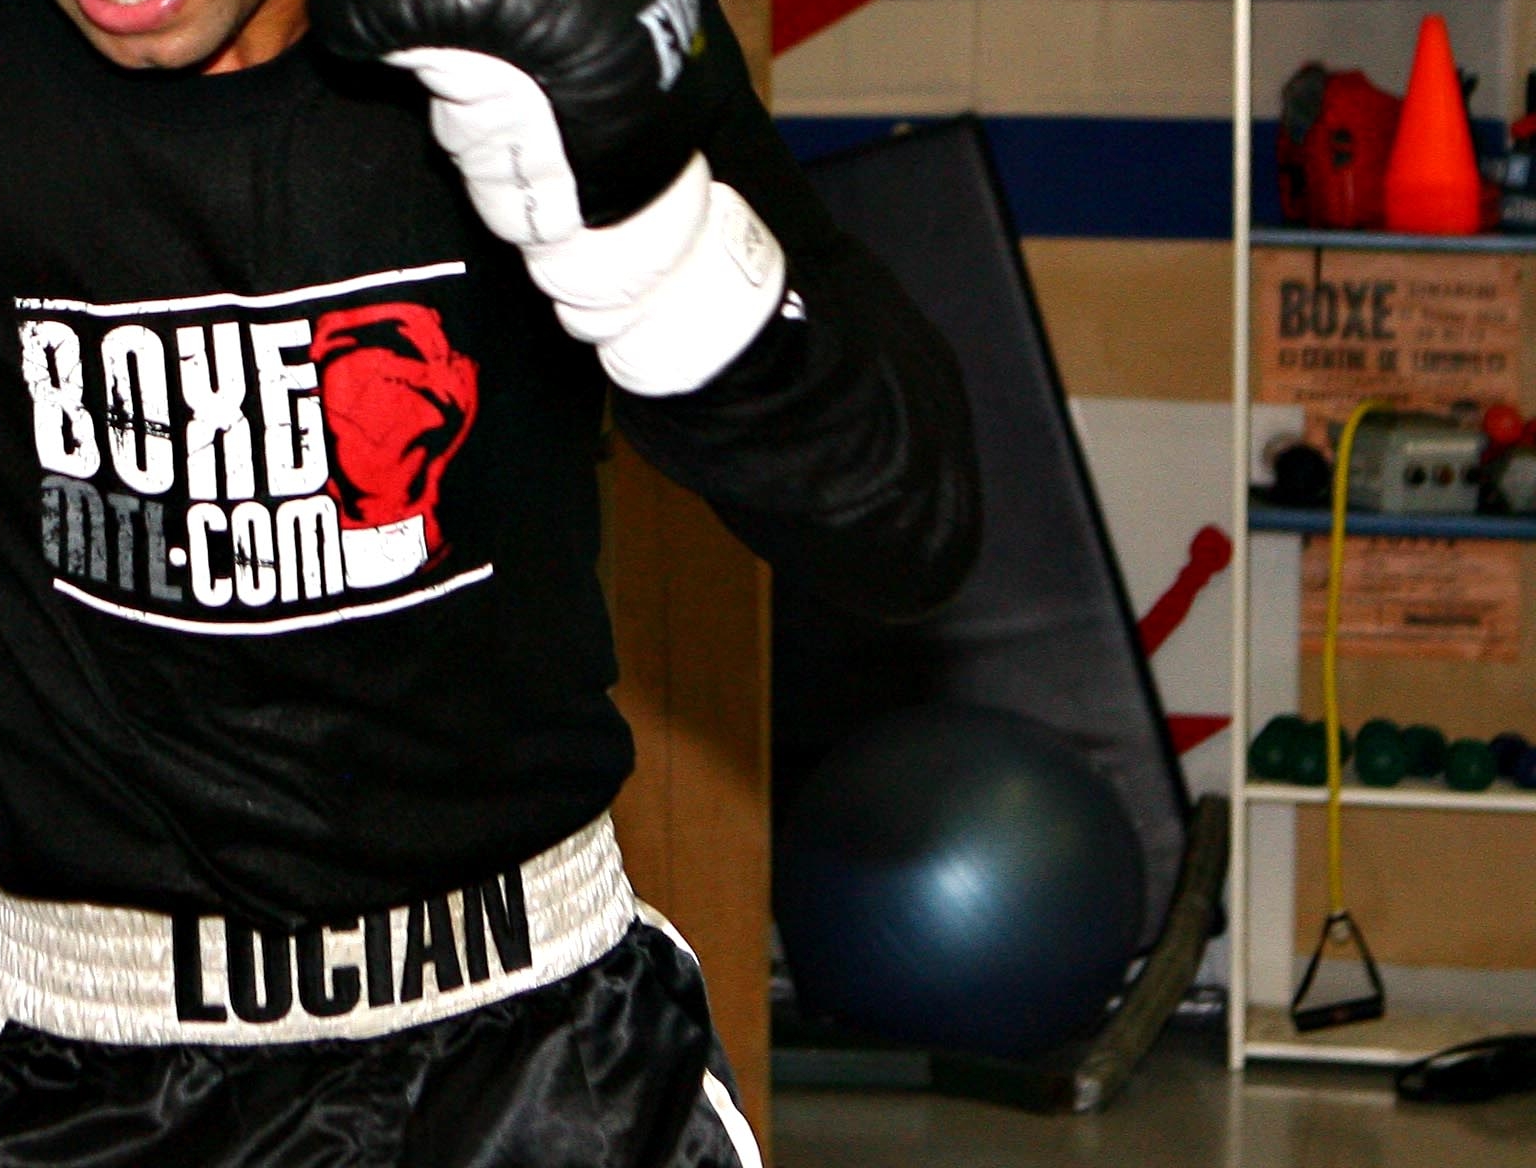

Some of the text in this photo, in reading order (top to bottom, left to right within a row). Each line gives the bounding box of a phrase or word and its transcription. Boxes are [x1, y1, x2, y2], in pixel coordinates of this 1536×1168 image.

[1279, 281, 1396, 339] BOXE
[18, 319, 329, 500] BOXE
[171, 866, 533, 1024] LUCIAN
